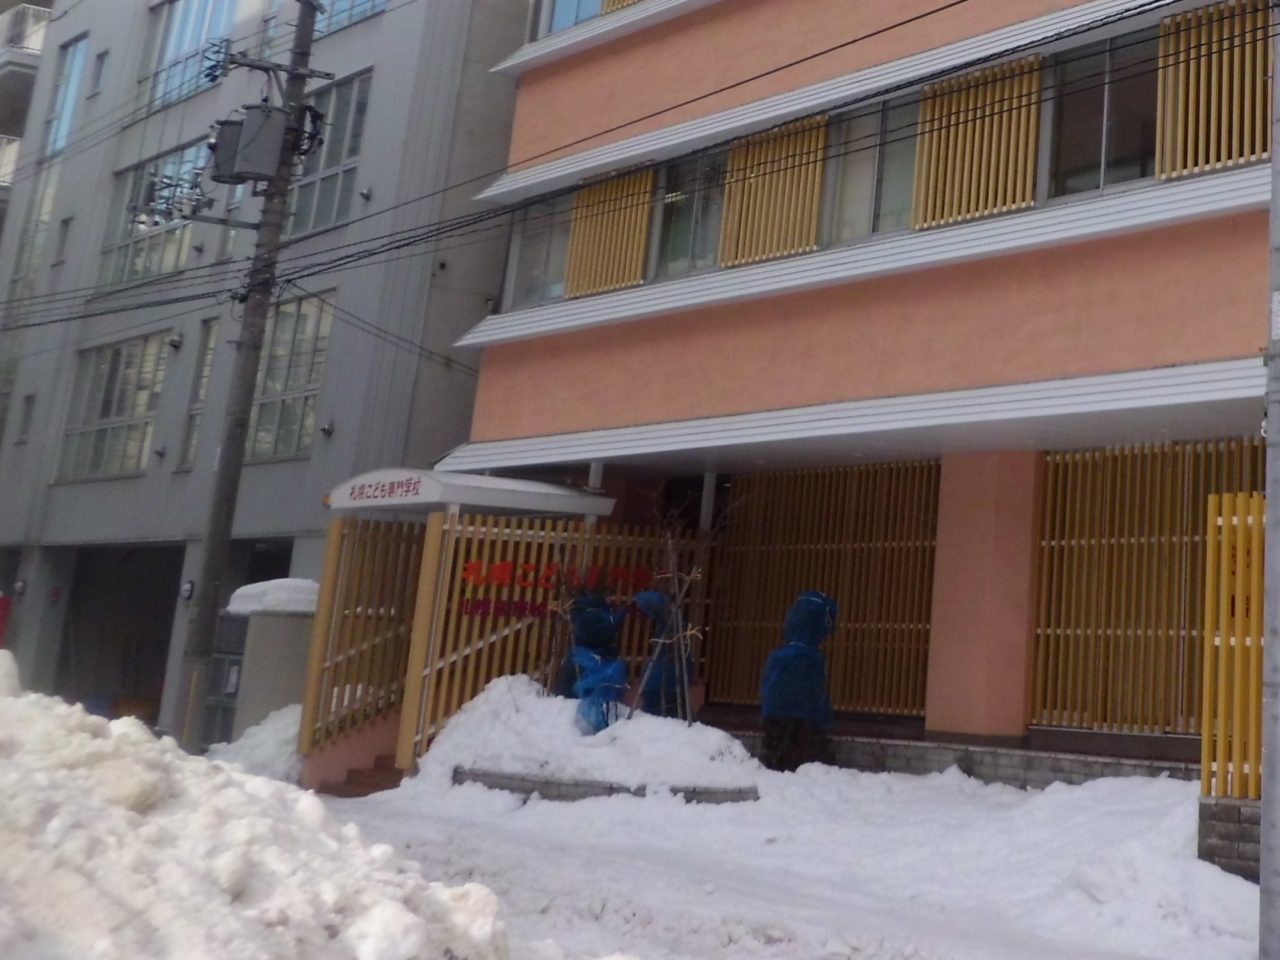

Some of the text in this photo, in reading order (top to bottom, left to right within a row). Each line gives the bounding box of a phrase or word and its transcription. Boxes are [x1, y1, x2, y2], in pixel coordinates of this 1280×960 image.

[350, 477, 421, 500] 札幌こども専門学校
